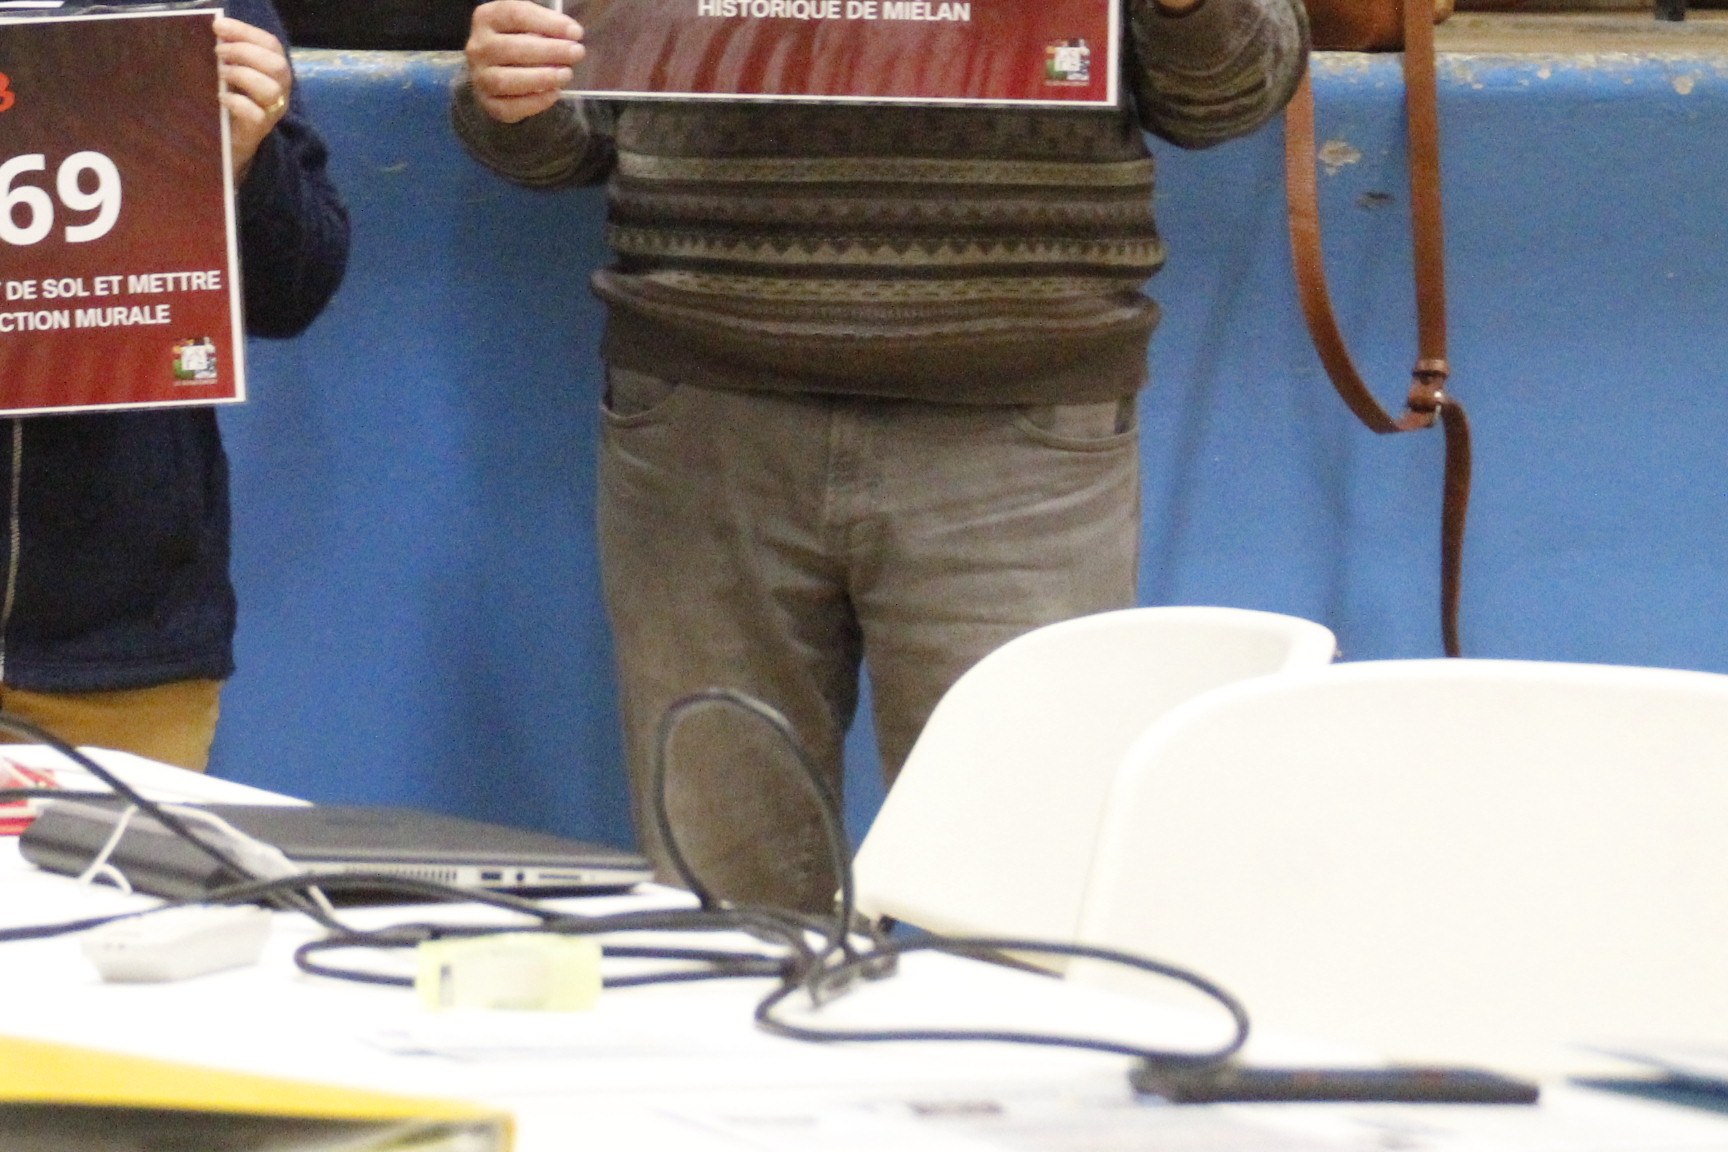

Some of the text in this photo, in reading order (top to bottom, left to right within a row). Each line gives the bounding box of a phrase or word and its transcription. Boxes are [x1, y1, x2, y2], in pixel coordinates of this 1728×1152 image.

[846, 1, 877, 20] DE
[6, 280, 37, 301] DE
[42, 277, 90, 298] SOL
[94, 275, 123, 296] ET
[128, 270, 221, 294] METTRE
[75, 304, 171, 328] MURALE
